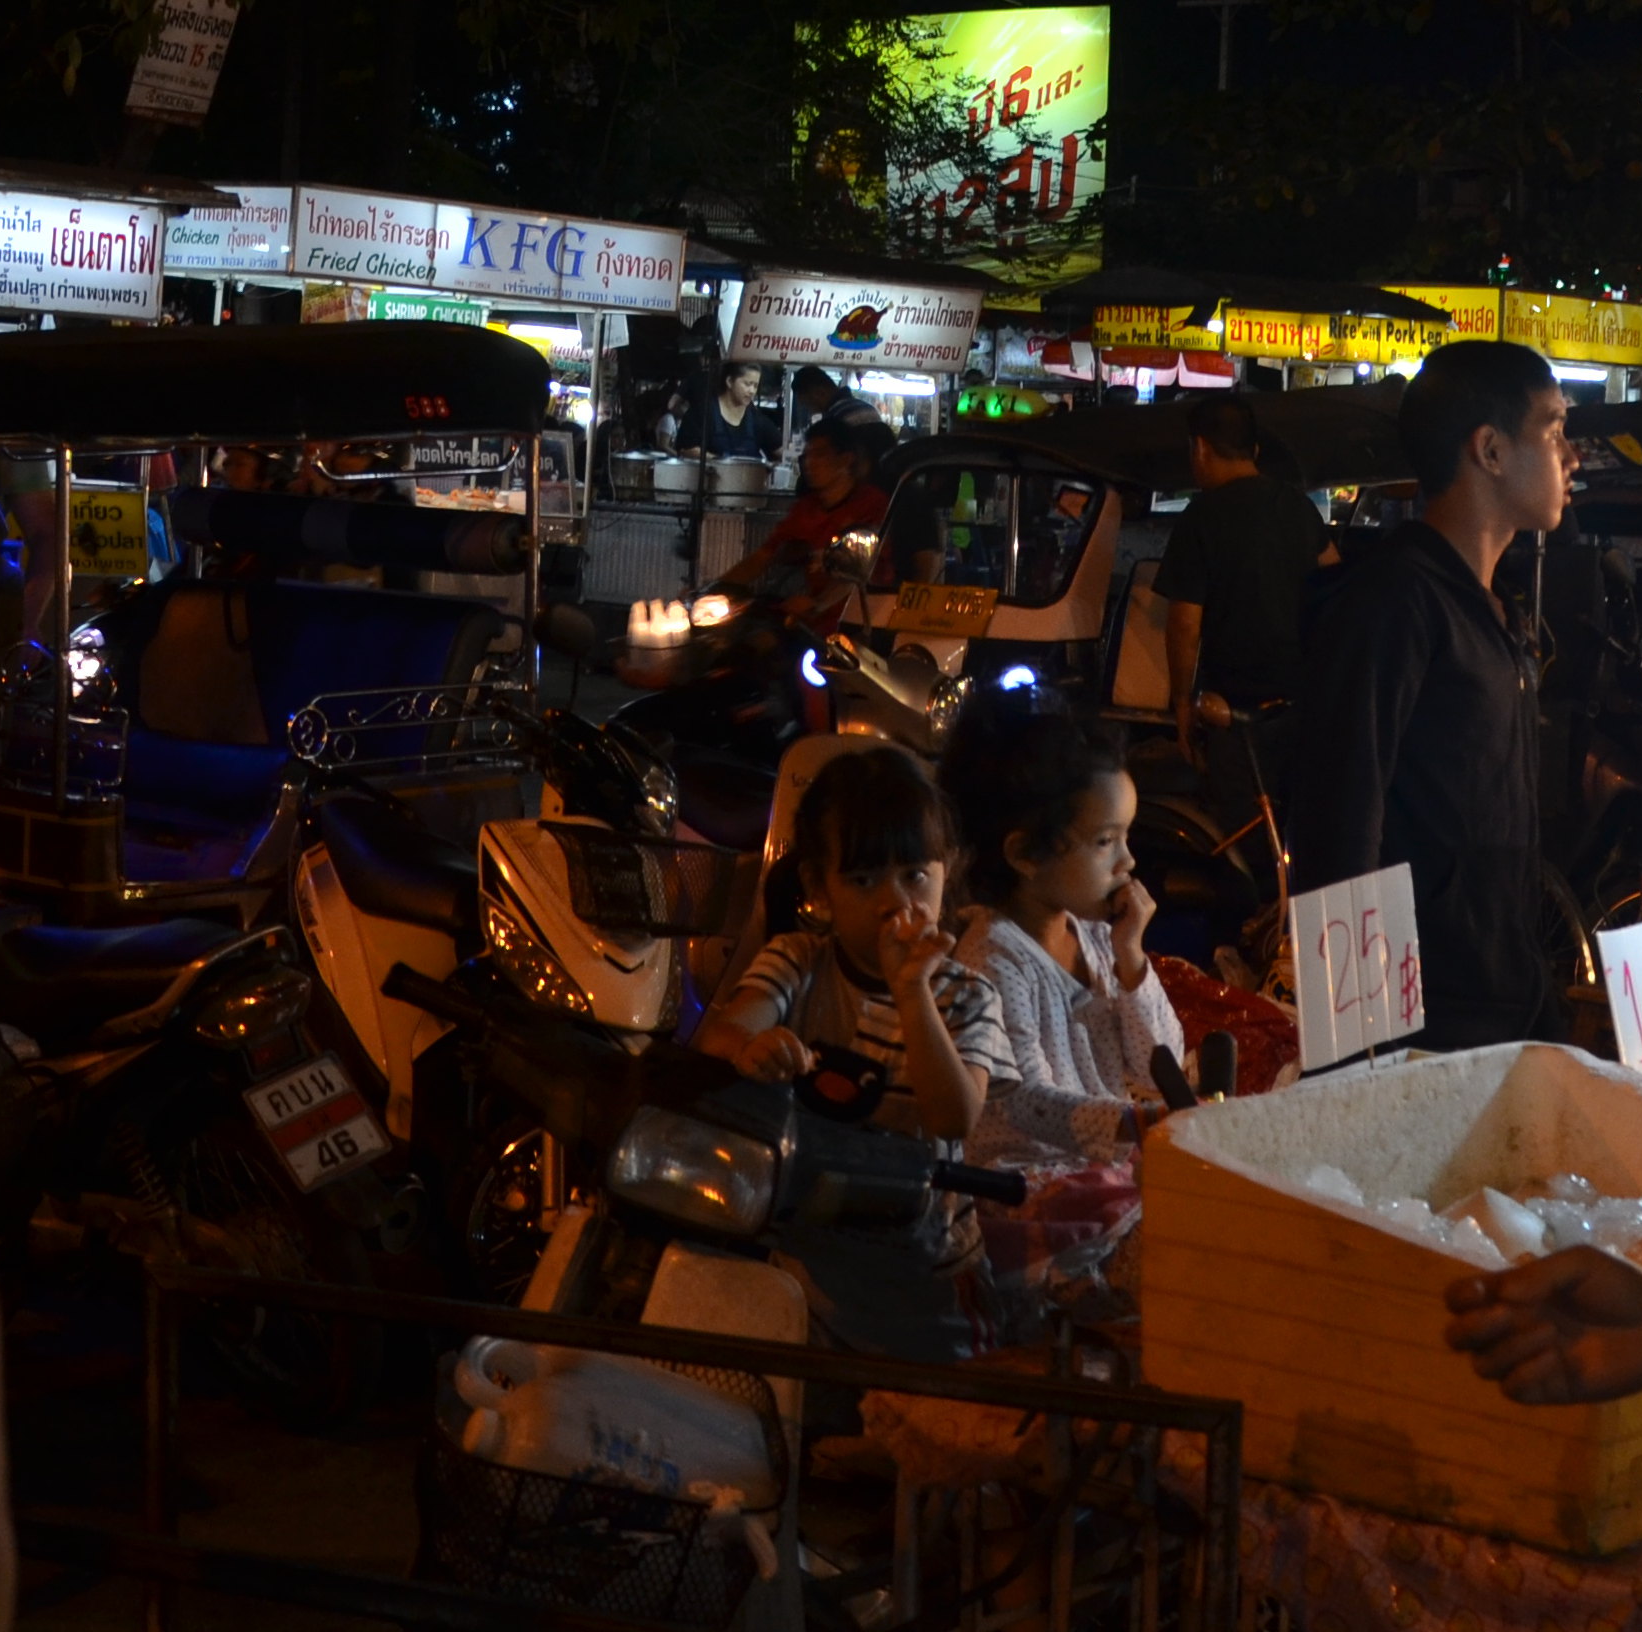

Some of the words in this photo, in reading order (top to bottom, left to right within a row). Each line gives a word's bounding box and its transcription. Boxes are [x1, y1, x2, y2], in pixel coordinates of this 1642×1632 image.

[189, 43, 207, 68] 15
[50, 208, 158, 276] เย็นตาโฟ
[171, 226, 220, 246] Chicken
[306, 197, 449, 262] ไก่ทอดไร้กระดูก
[307, 247, 361, 273] Fried
[366, 252, 437, 281] Chicken
[459, 216, 587, 280] KFG
[595, 237, 673, 289] กุ้งทอด
[385, 301, 428, 320] SHRIMP
[749, 283, 835, 319] ข้าวมันไก่
[742, 325, 820, 360] ข้าวหมูแดง
[884, 333, 962, 366] ข้าวหมูกรอบ
[1385, 321, 1417, 345] Pork
[967, 391, 1017, 413] TAXI
[317, 1130, 359, 1169] 46
